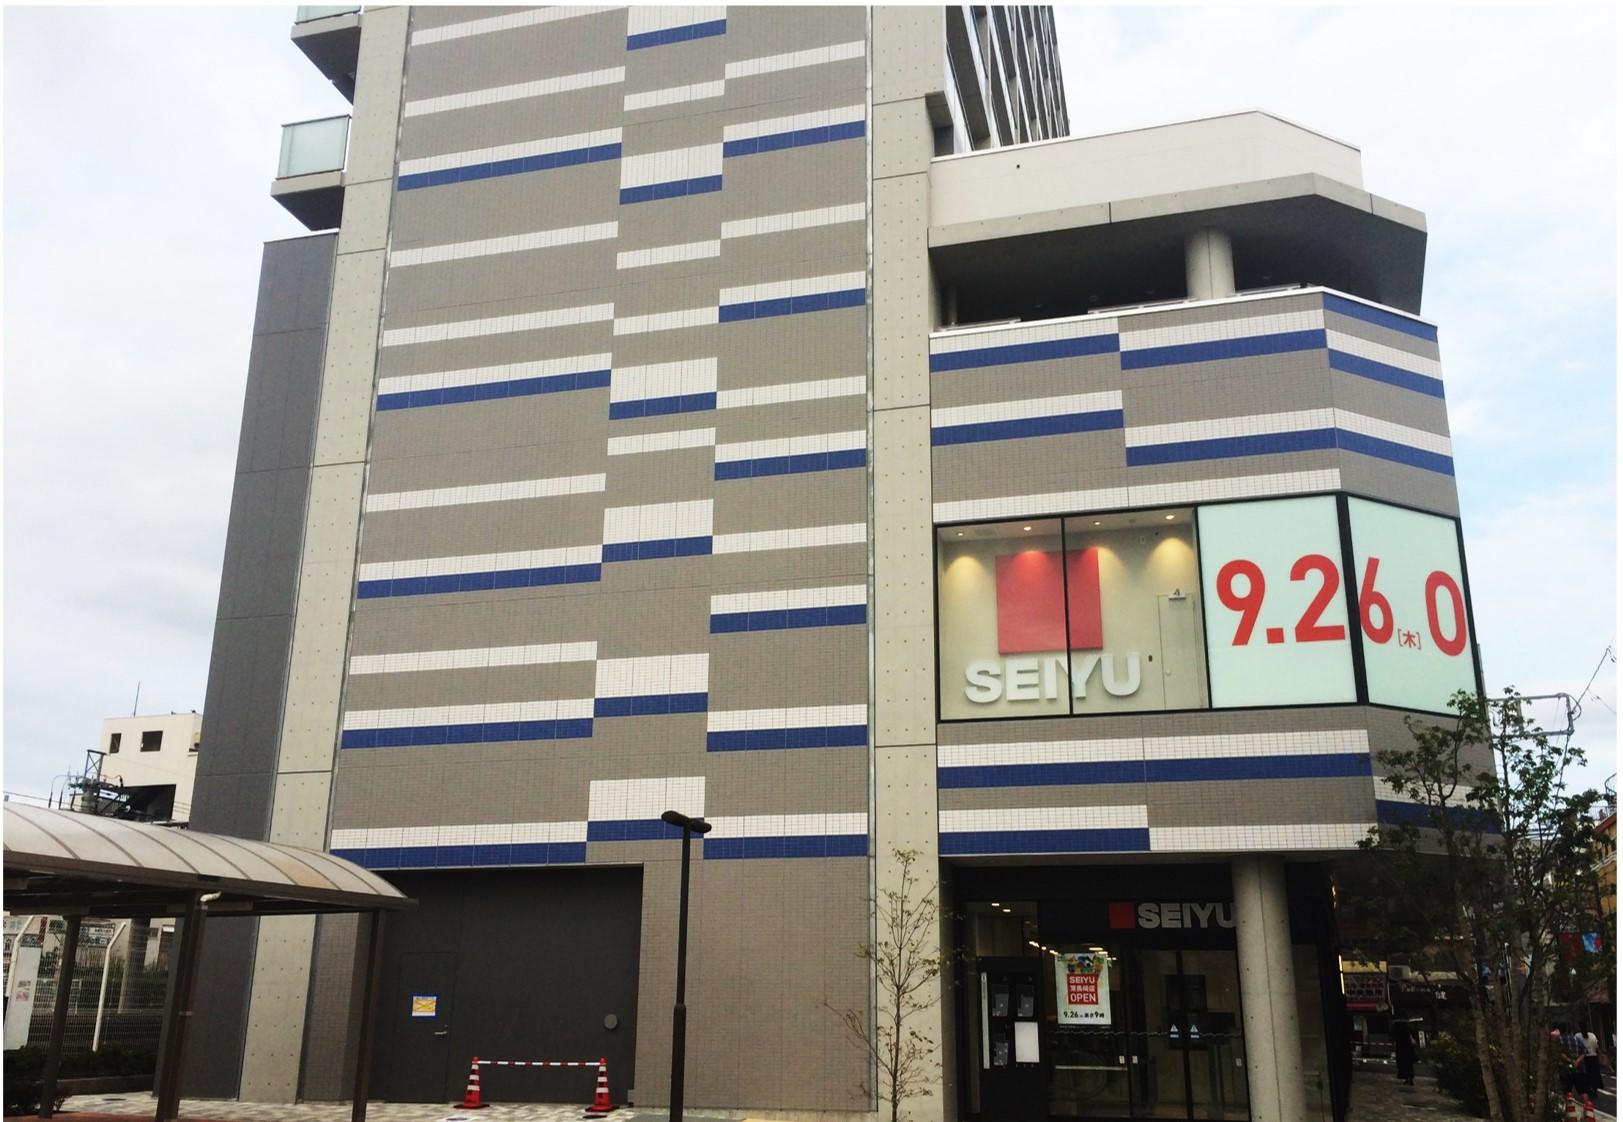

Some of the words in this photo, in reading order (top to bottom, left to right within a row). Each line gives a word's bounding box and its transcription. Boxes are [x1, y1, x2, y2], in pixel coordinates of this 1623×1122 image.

[964, 652, 1141, 704] SEIYU
[1137, 902, 1237, 929] SEIYU
[1069, 976, 1095, 984] SEIYU
[1070, 992, 1096, 1003] OPEN
